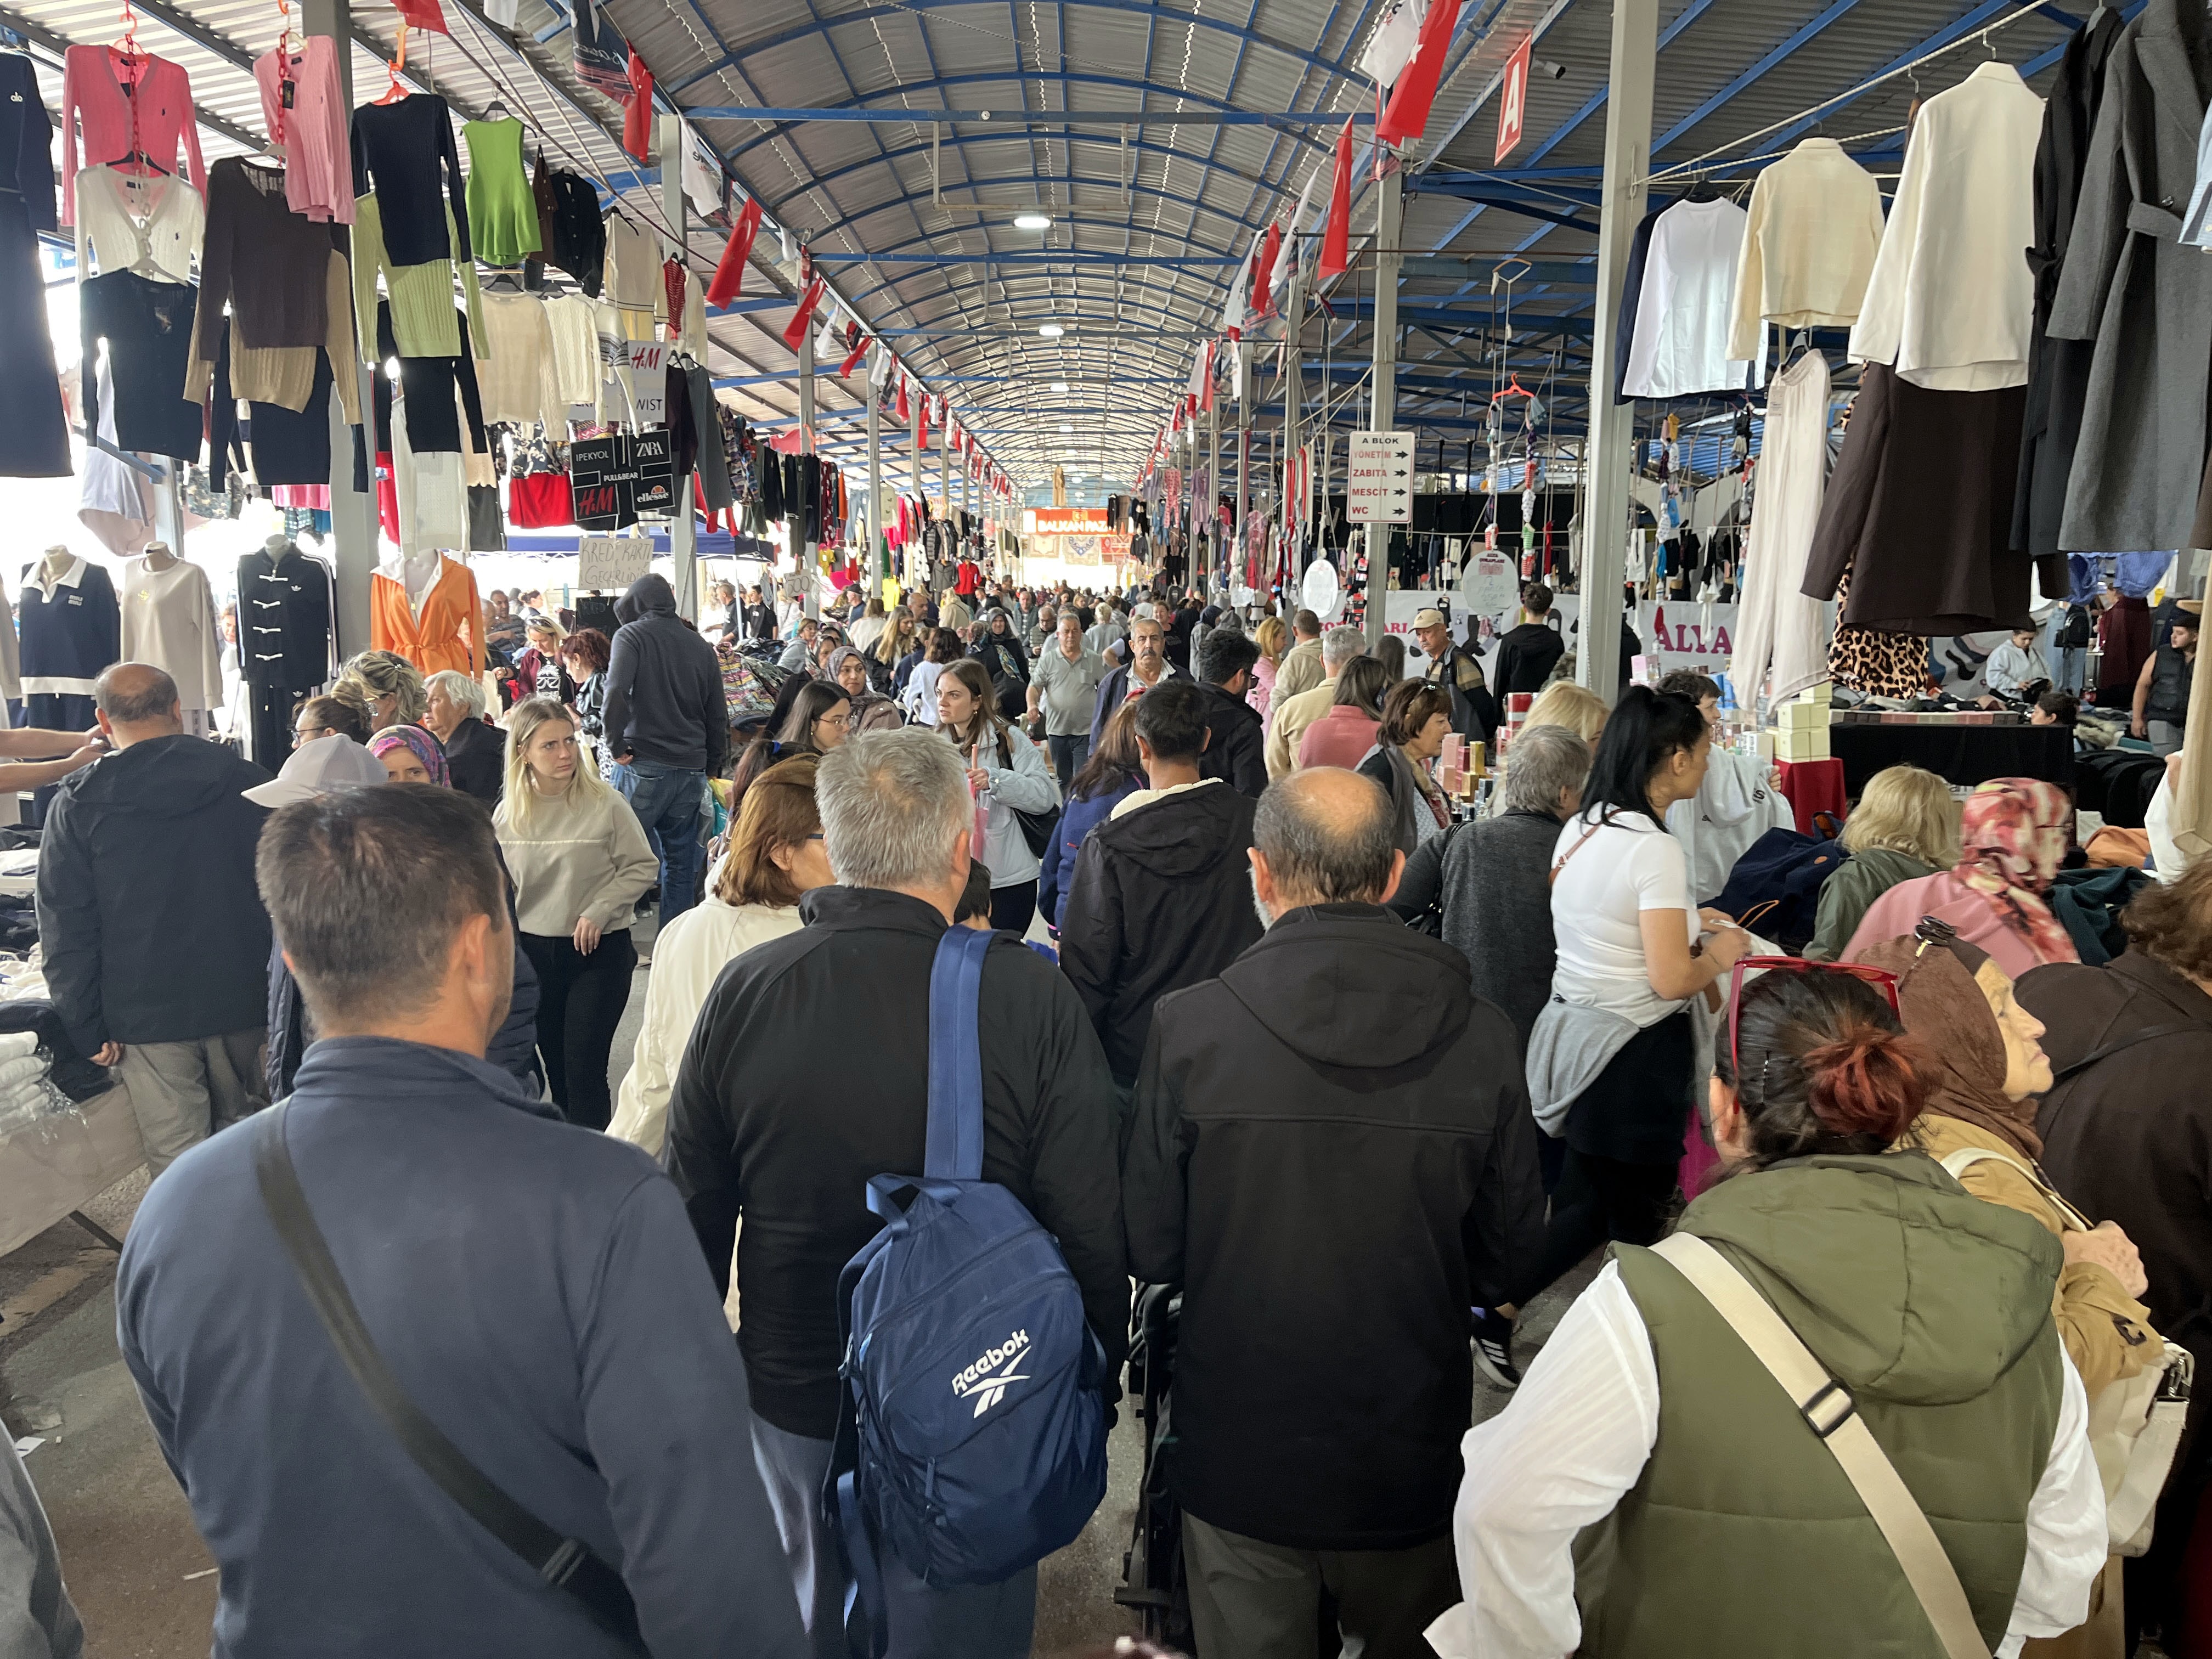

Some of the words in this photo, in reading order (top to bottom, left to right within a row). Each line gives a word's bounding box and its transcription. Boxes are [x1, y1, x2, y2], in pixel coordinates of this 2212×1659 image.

[1499, 61, 1520, 146] A
[631, 347, 661, 370] H&M
[576, 450, 609, 462] IPEKYOL
[636, 441, 664, 458] ZARA
[603, 472, 639, 482] PULL&BEAR
[1353, 469, 1387, 477] ZABITA
[578, 486, 614, 516] H&M
[636, 492, 669, 503] ellesse
[1037, 520, 1084, 532] BALKAN
[951, 1328, 1029, 1396] Reebok
